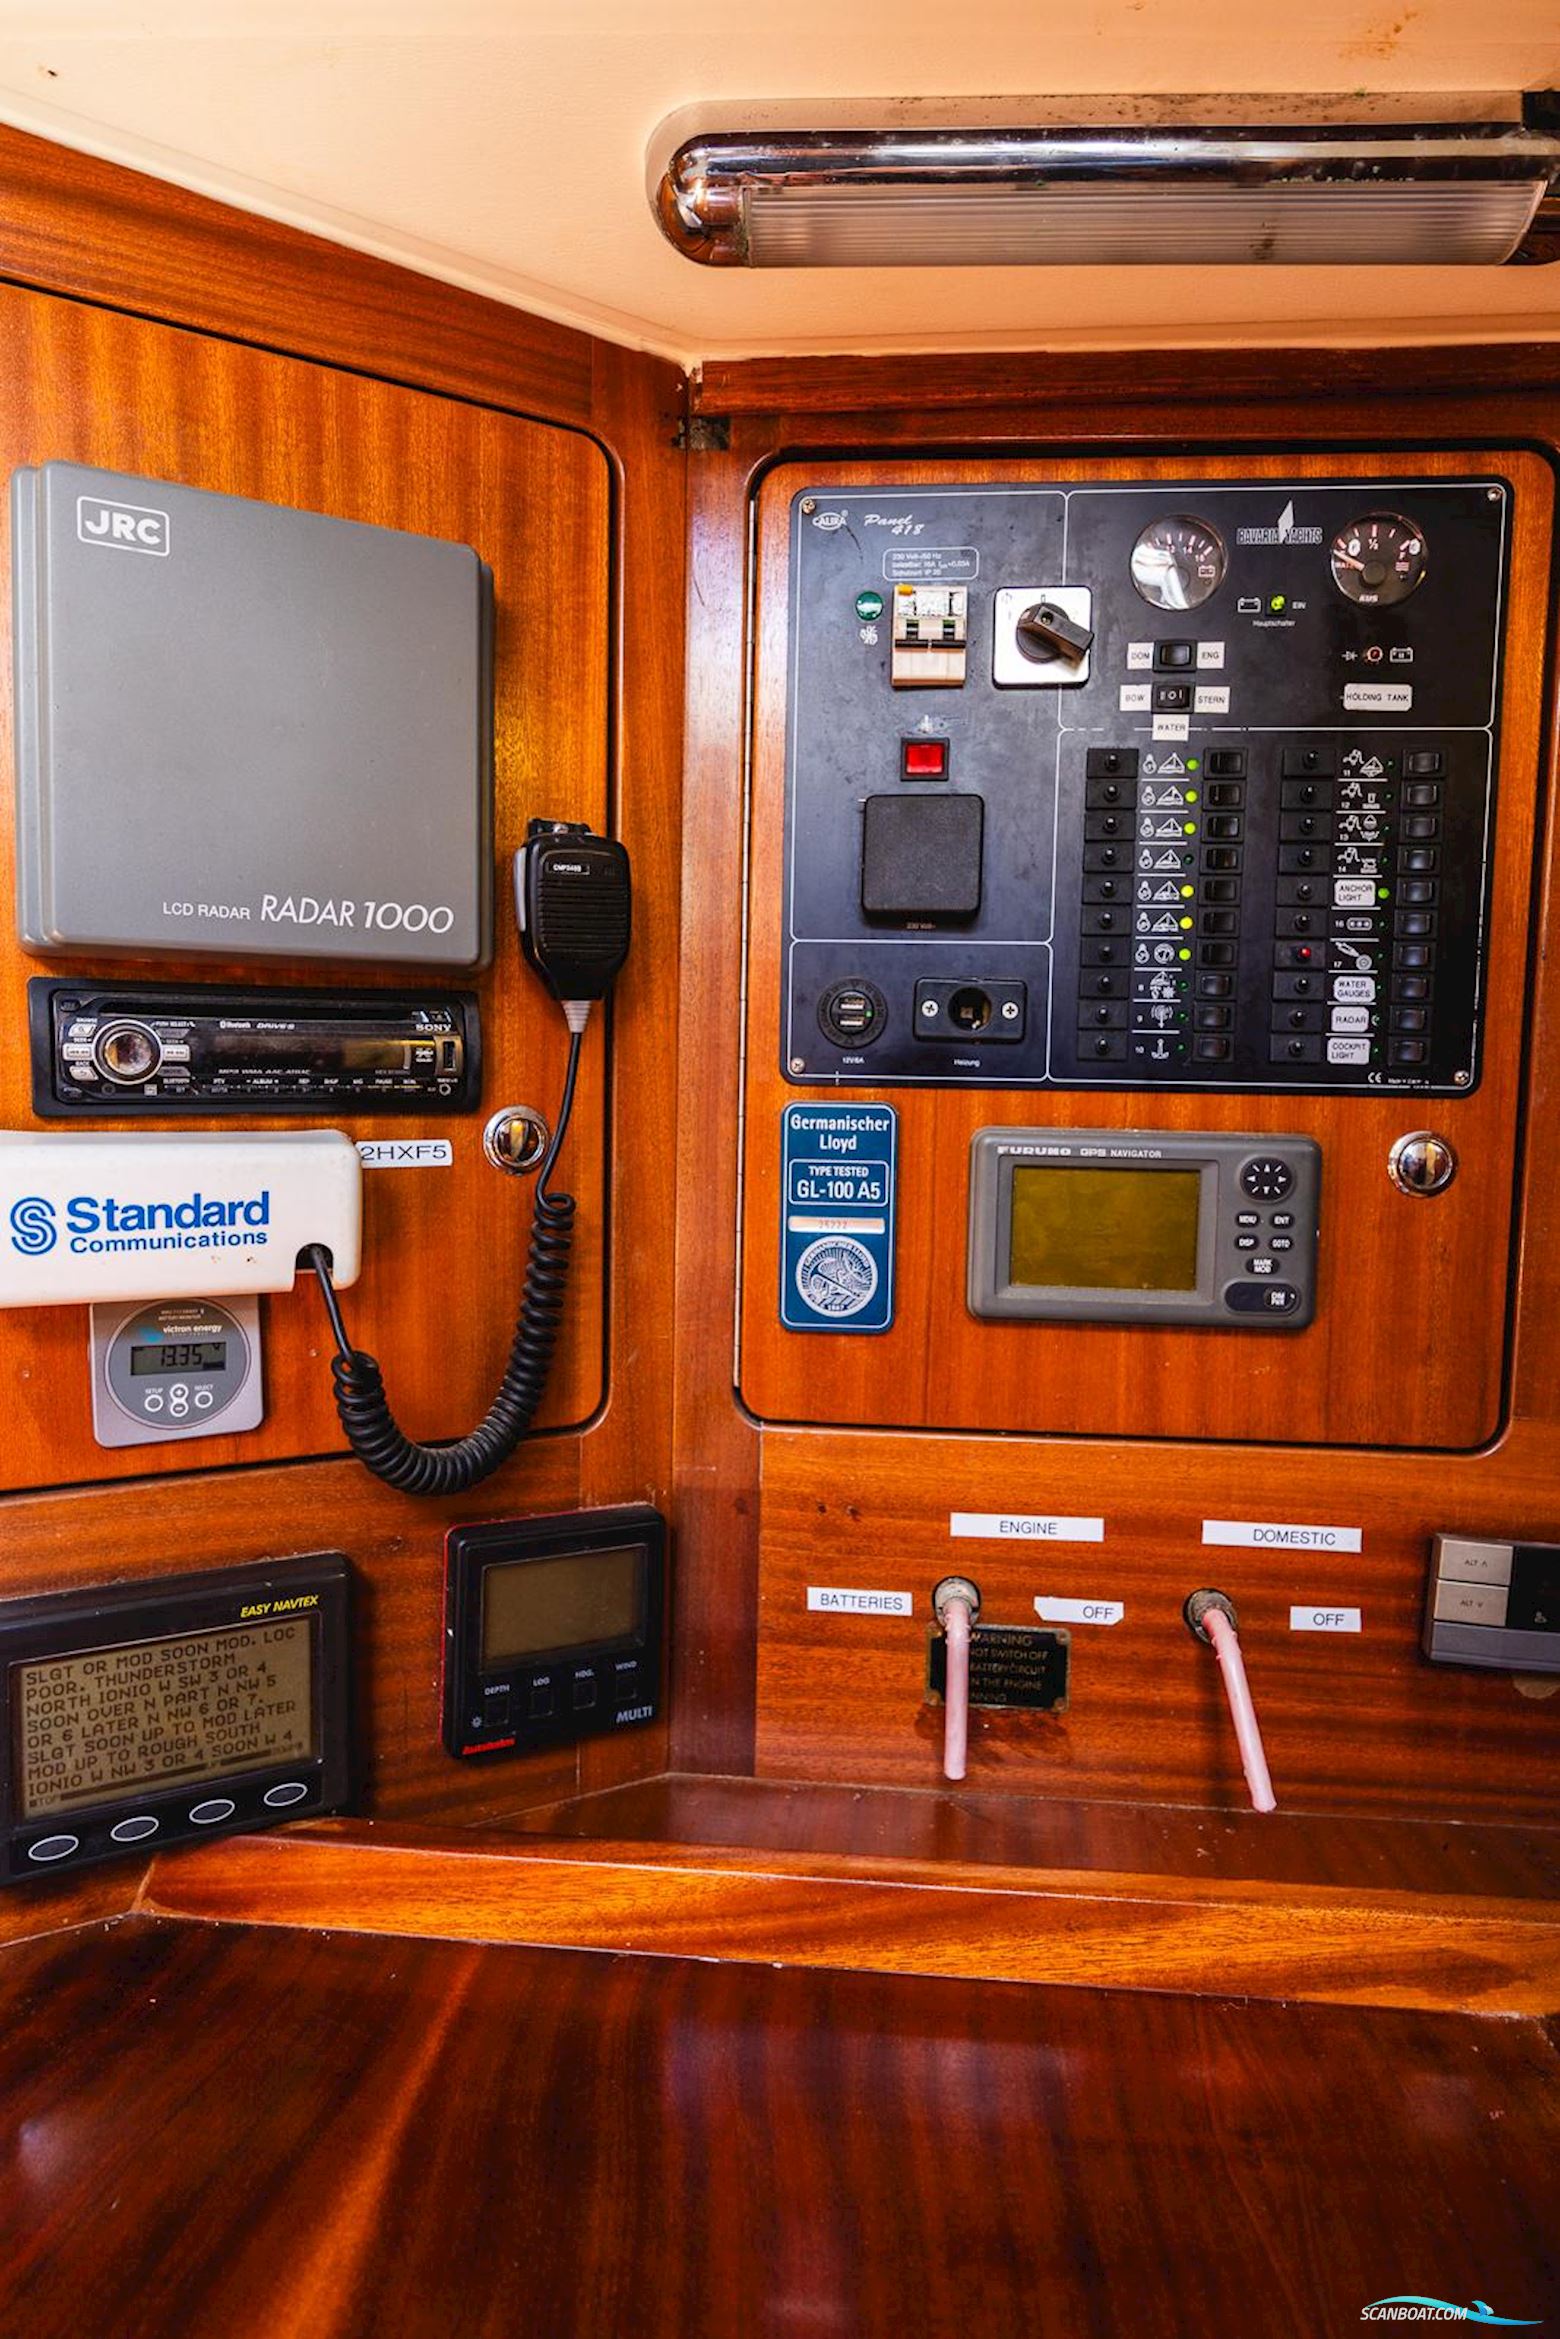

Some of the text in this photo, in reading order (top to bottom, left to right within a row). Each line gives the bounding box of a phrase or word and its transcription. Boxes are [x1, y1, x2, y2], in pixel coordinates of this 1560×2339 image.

[85, 509, 162, 545] JRC
[864, 513, 913, 527] Panel
[891, 524, 925, 536] 418
[1131, 652, 1150, 660] DOM
[1201, 651, 1220, 659] ENG
[1125, 694, 1145, 702] BOW
[1197, 695, 1226, 704] STERN
[1345, 693, 1410, 702] HOLDING TANK
[1339, 884, 1373, 893] ANCHOR
[1338, 893, 1363, 902] LIGHT
[162, 894, 455, 934] LCD RADAR RADAR 1000
[1338, 980, 1368, 989] WATER
[1337, 989, 1371, 998] GAUGES
[415, 1023, 452, 1032] SONY
[1335, 1015, 1367, 1025] RADAR
[1332, 1042, 1367, 1051] COCKPIT
[1331, 1050, 1356, 1060] LIGHT
[790, 1114, 890, 1132] Germanischer
[819, 1134, 857, 1154] Lloyd
[360, 1144, 447, 1162] 2HXF5
[997, 1145, 1162, 1159] FURUNO GPS NAVIGATOR
[808, 1165, 869, 1178] TYPE TESTED
[797, 1180, 881, 1200] GL-100 A5
[67, 1191, 270, 1234] Standard
[1273, 1215, 1290, 1225] ENT
[70, 1230, 268, 1254] Communications
[163, 1325, 192, 1334] victron
[193, 1324, 223, 1334] energy
[1000, 1520, 1058, 1536] ENGINE
[1253, 1528, 1336, 1546] DOMESTIC
[240, 1595, 320, 1618] EASY NAVTEX
[820, 1592, 904, 1611] BATTERIES
[1082, 1605, 1115, 1620] OFF
[1312, 1612, 1345, 1627] OFF
[26, 1627, 296, 1686] SLGT OR MOD SOON MOD. LOC
[616, 1660, 638, 1671] WIND
[26, 1653, 235, 1702] POOR. THUNDERSTORM
[533, 1676, 550, 1687] LOG
[26, 1661, 267, 1718] NORTH IONIO W SW 3 OR 4
[484, 1684, 510, 1696] DEPTH
[27, 1674, 277, 1733] SOON OVER N PART N NW 5
[616, 1706, 653, 1723] MULTI
[27, 1734, 52, 1750] OR
[62, 1729, 73, 1742] 6
[82, 1717, 139, 1739] LATER
[148, 1713, 160, 1725] N
[167, 1706, 192, 1722] NW
[199, 1702, 210, 1716] 6
[216, 1698, 240, 1713] OR
[27, 1701, 296, 1766] SLGT SOON UP TO MOD LATER
[28, 1722, 261, 1781] MOD UP TO ROUGH SOUTH
[28, 1775, 83, 1797] IONIO
[91, 1770, 103, 1783] W
[111, 1763, 136, 1779] NW
[144, 1759, 155, 1772] 3
[162, 1752, 187, 1769] OR
[195, 1750, 204, 1762] 4
[212, 1738, 259, 1758] SOON
[265, 1733, 277, 1745] W
[283, 1729, 293, 1741] 4
